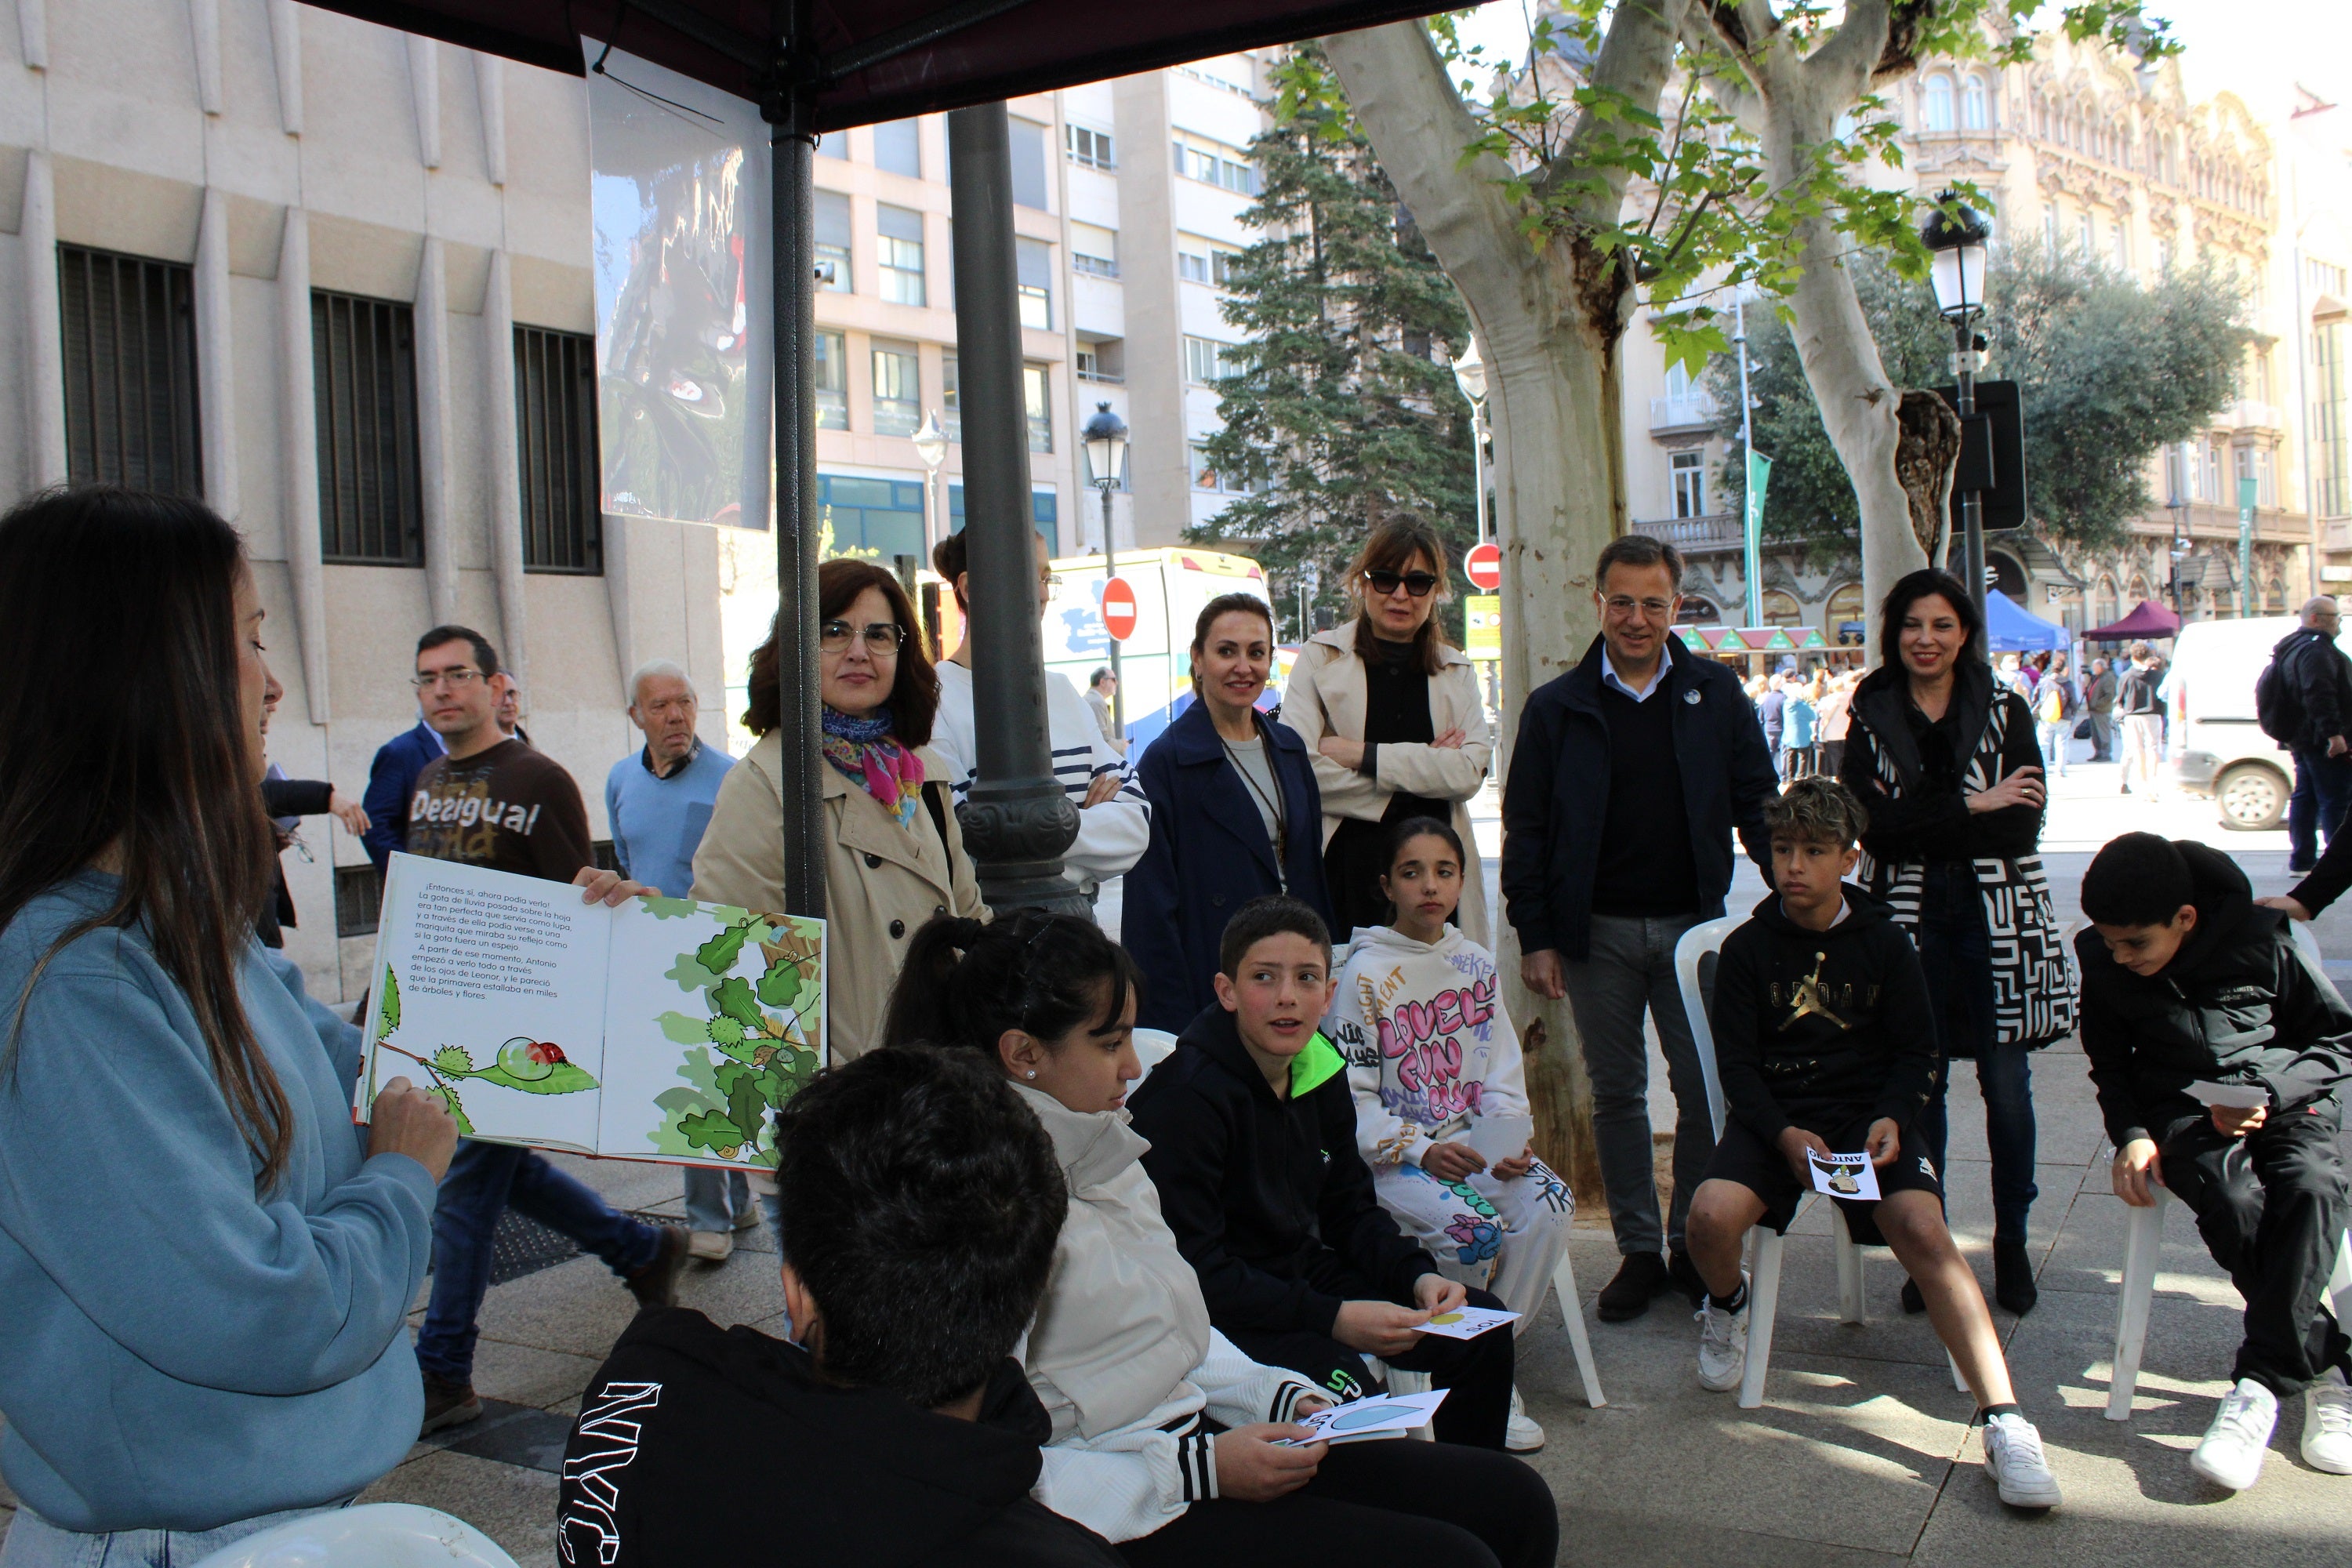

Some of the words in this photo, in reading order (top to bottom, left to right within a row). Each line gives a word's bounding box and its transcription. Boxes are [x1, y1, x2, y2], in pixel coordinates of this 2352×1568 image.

[409, 789, 541, 836] Desigual
[426, 883, 465, 895] ¡Entonces
[477, 891, 502, 900] ahora
[431, 913, 456, 923] través
[449, 907, 483, 916] perfecta
[503, 915, 527, 924] servía
[553, 921, 572, 931] lupa,
[487, 903, 518, 913] posada
[520, 908, 542, 916] sobre
[554, 912, 571, 922] hoja
[416, 922, 455, 932] mariquita
[475, 929, 505, 938] miraba
[519, 935, 543, 946] reflejo
[455, 936, 477, 945] fuera
[492, 942, 521, 951] espejo.
[412, 955, 446, 964] empezó
[507, 965, 532, 974] través
[482, 953, 524, 964] momento,
[526, 957, 557, 967] Antonio
[424, 964, 437, 973] los
[438, 966, 456, 975] ojos
[471, 970, 501, 981] Leonor,
[520, 978, 550, 986] pareció
[422, 985, 453, 995] árboles
[463, 989, 488, 1000] flores.
[438, 978, 481, 988] primavera
[483, 984, 521, 993] estallaba
[536, 989, 558, 997] miles
[1398, 1036, 1463, 1092] FUN
[1465, 1319, 1505, 1332] SOL
